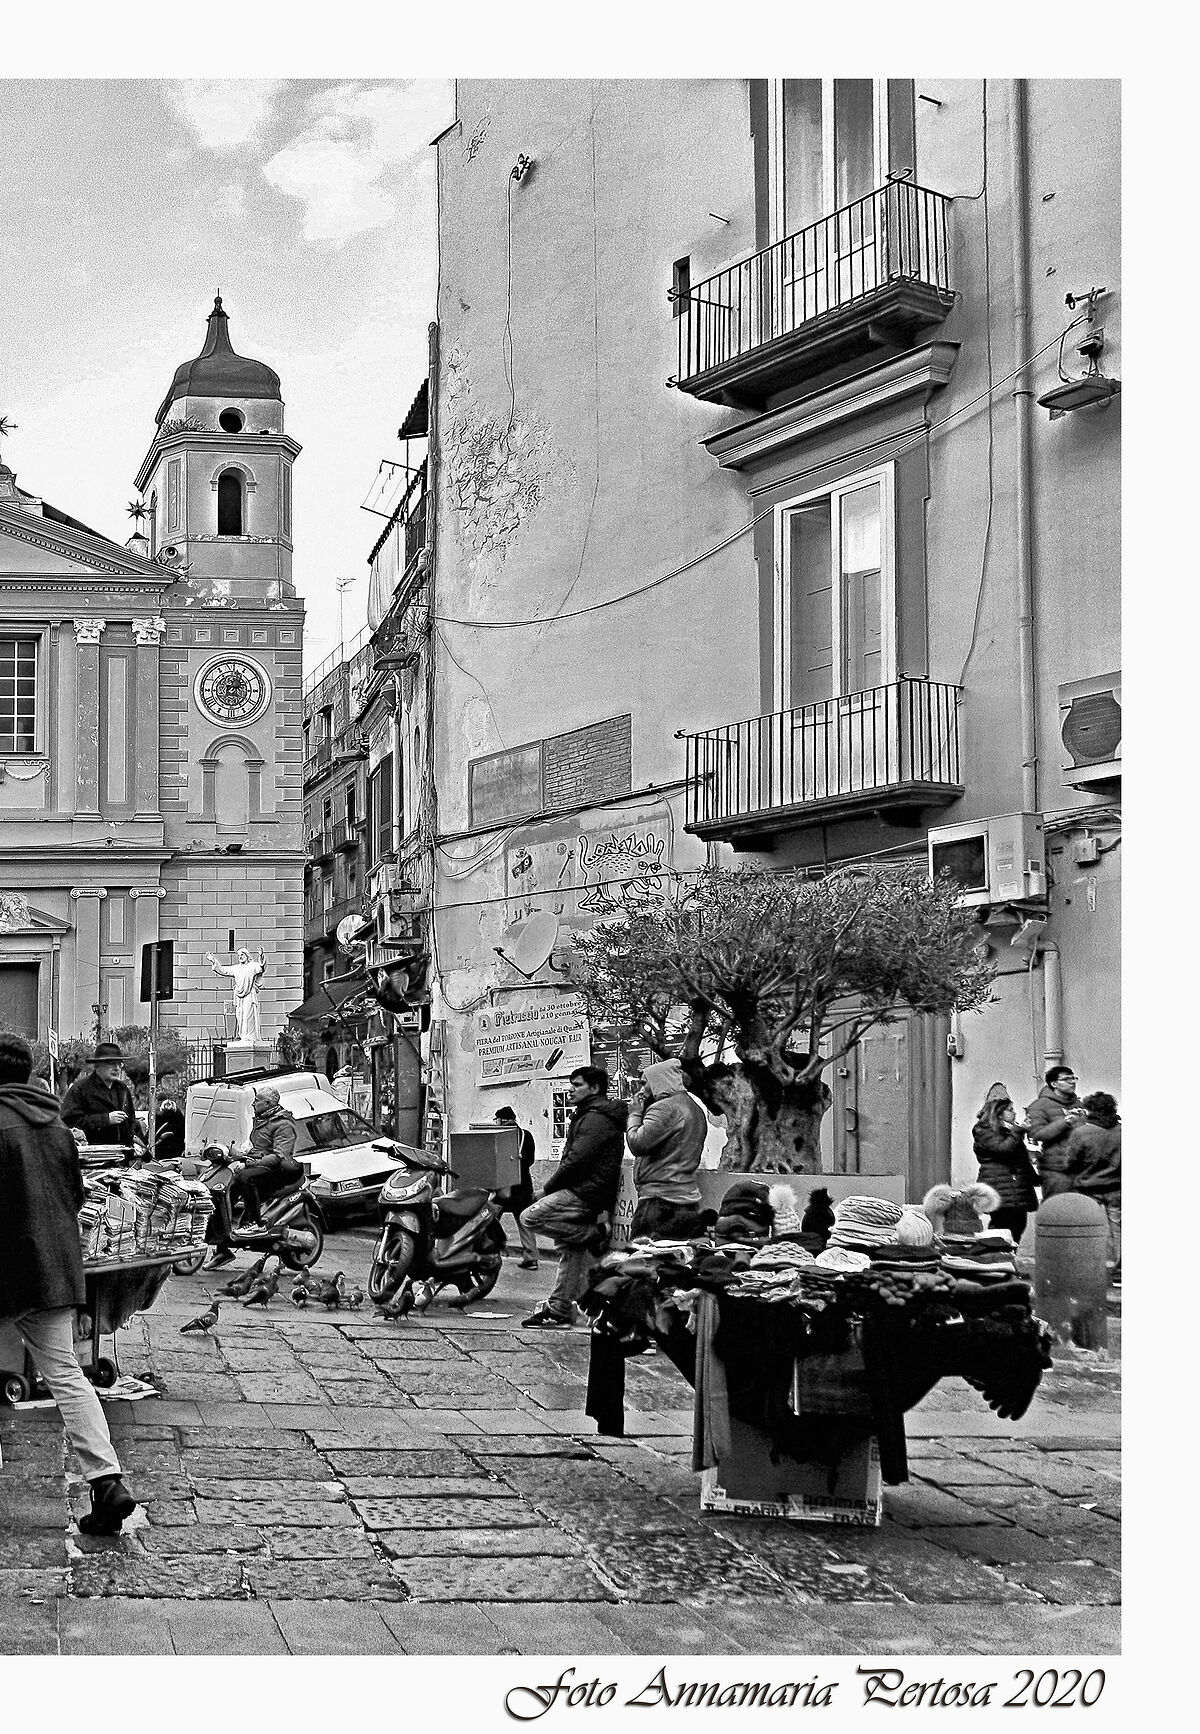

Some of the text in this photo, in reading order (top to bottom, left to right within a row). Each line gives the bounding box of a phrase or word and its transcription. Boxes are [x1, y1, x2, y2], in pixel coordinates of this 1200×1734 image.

[556, 1000, 582, 1010] ottobre
[546, 1011, 554, 1019] 10
[476, 1037, 493, 1046] FIERA
[492, 1035, 501, 1044] del
[501, 1031, 526, 1042] TORRONE
[478, 1033, 583, 1056] PREMIUM ARTISANAL NOUGAT FAIR
[733, 1503, 790, 1519] FRAGILE
